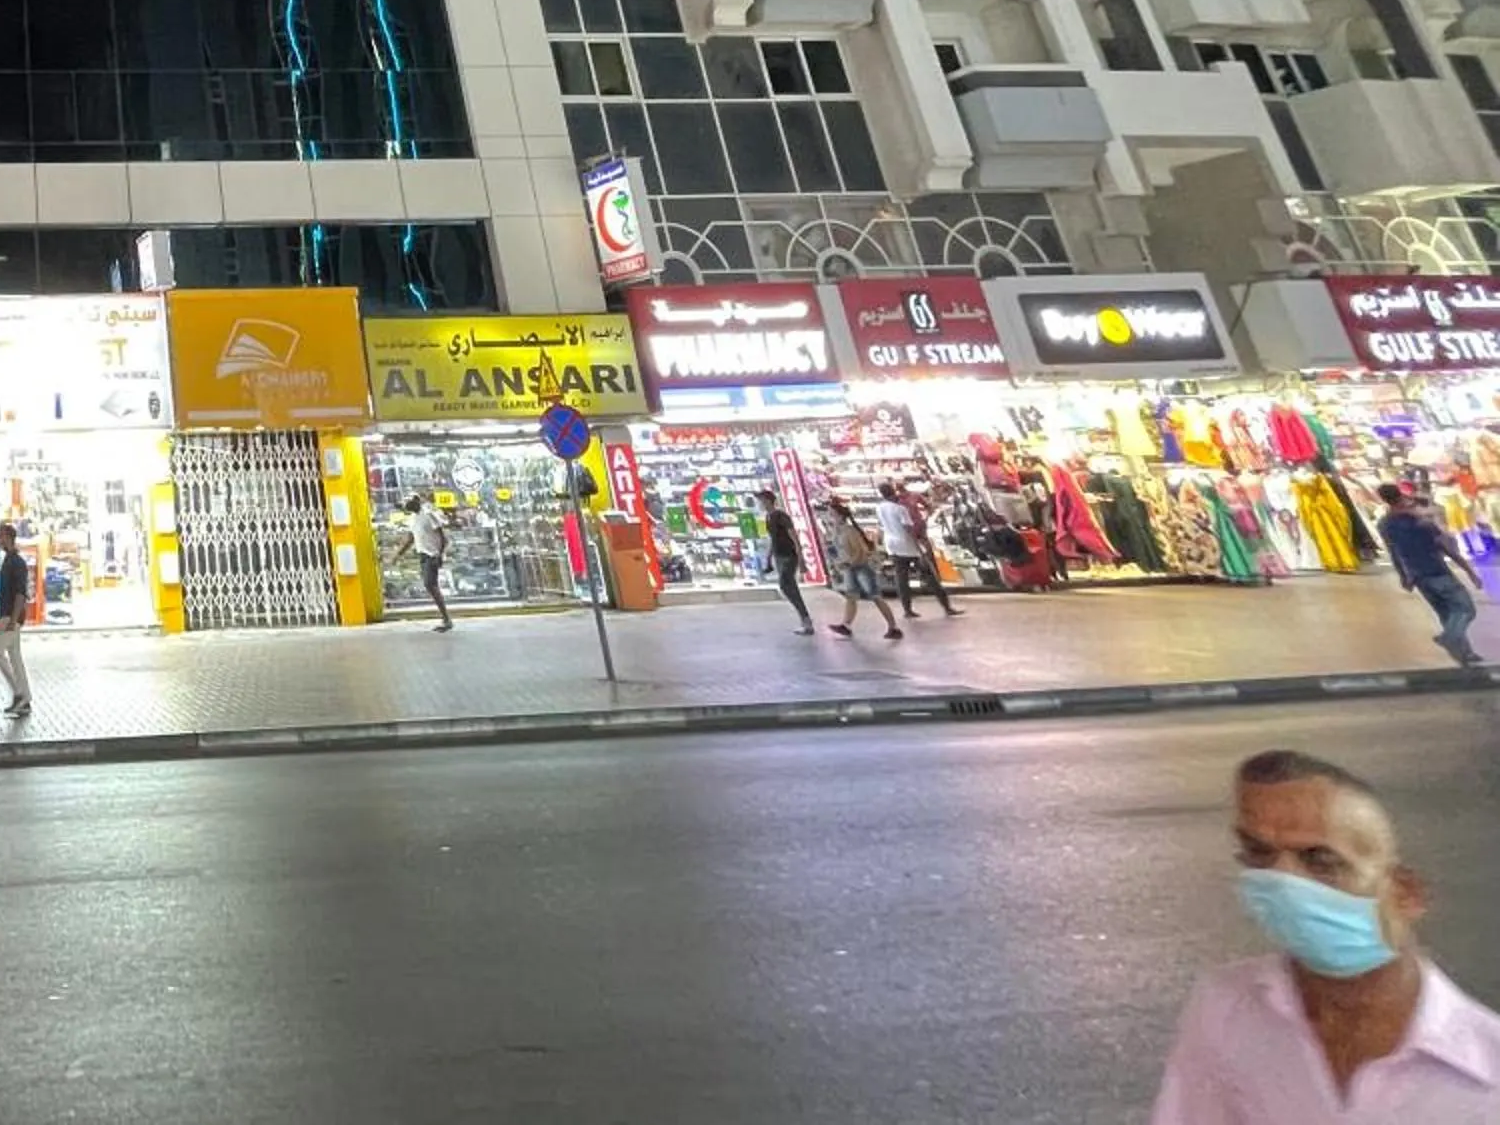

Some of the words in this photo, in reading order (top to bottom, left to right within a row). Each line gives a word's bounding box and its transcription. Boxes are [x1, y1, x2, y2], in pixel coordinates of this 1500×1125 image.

[650, 330, 828, 377] PHARMACY
[868, 344, 920, 366] GUF
[923, 342, 1005, 366] STREAM
[1368, 331, 1435, 363] GULF
[382, 367, 444, 398] AL
